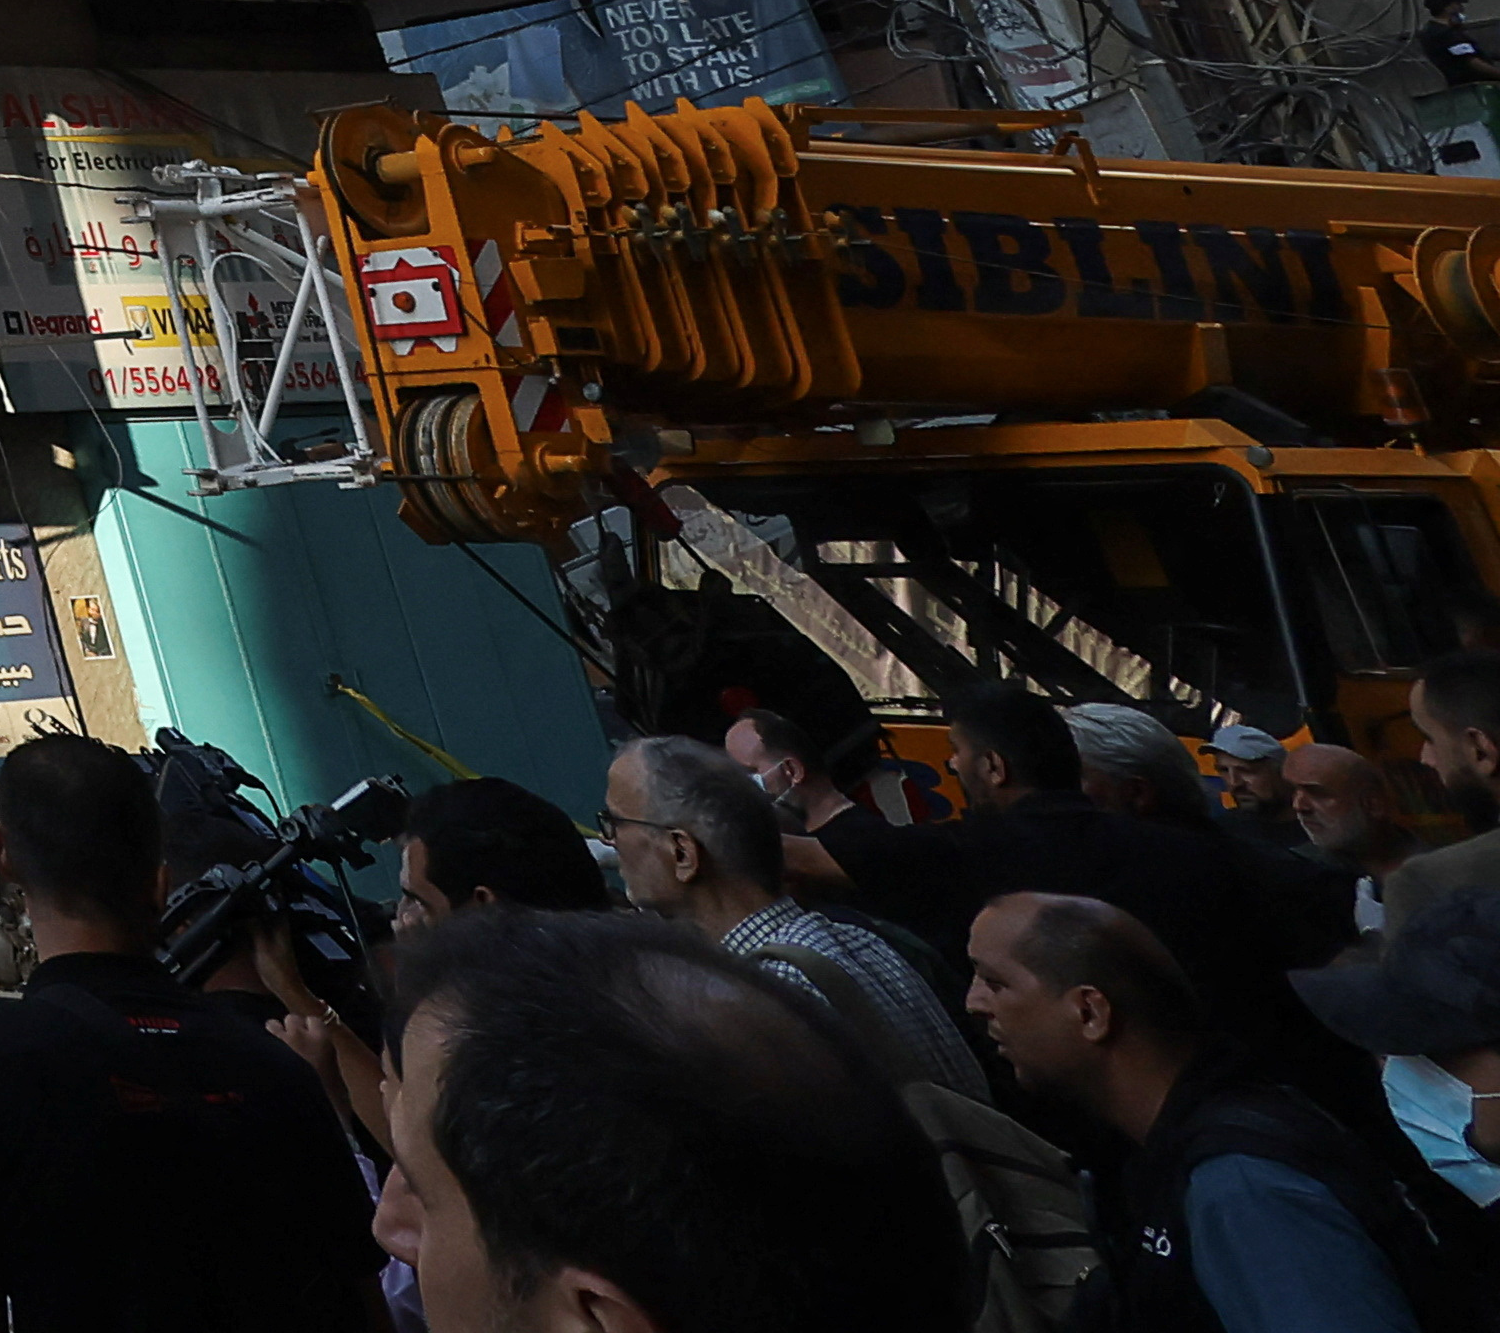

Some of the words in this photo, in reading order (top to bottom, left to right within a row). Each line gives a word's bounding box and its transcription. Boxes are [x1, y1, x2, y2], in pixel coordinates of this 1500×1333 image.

[613, 22, 669, 52] TOO
[679, 11, 756, 43] LATE
[621, 50, 661, 76] TO
[666, 35, 761, 68] START
[630, 71, 701, 101] WITH
[2, 93, 57, 129] AL
[35, 150, 67, 172] For
[828, 202, 1344, 325] SIBLINI
[17, 309, 102, 336] legrand
